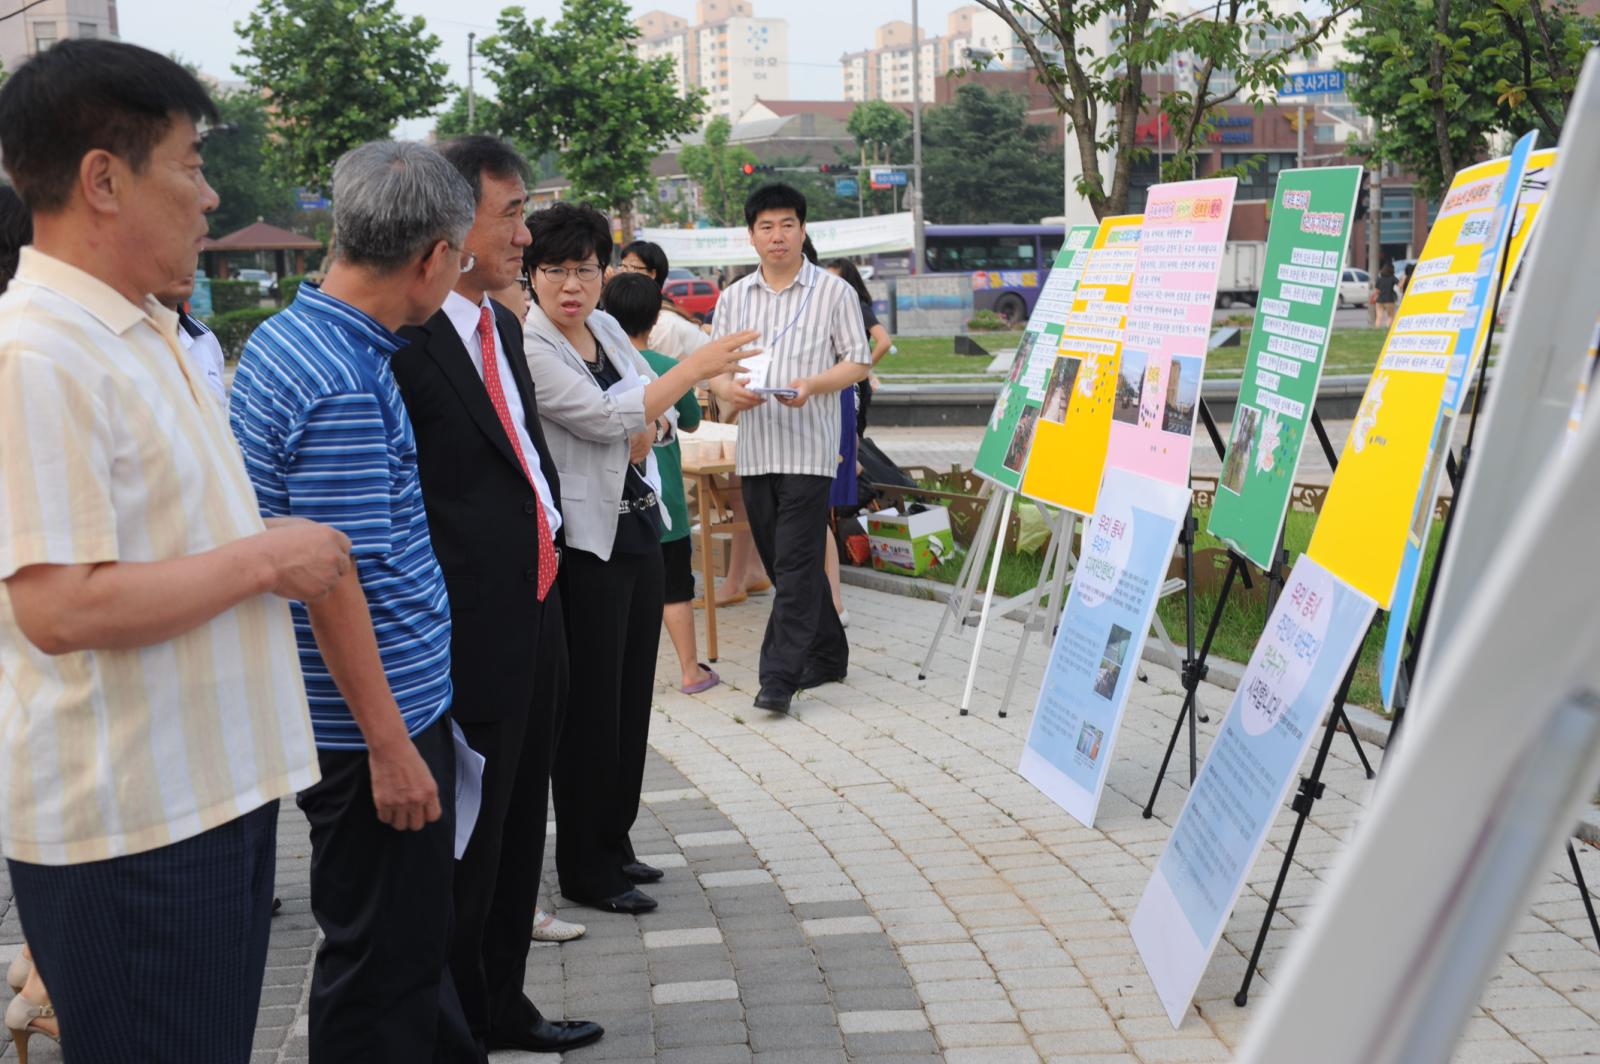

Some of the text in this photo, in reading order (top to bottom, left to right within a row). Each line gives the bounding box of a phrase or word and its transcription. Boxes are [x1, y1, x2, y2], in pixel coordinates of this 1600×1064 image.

[1098, 514, 1126, 540] 우리 동네
[1091, 535, 1111, 555] 우리가
[1291, 582, 1323, 621] 우리 동네
[1277, 613, 1299, 646] 주민이
